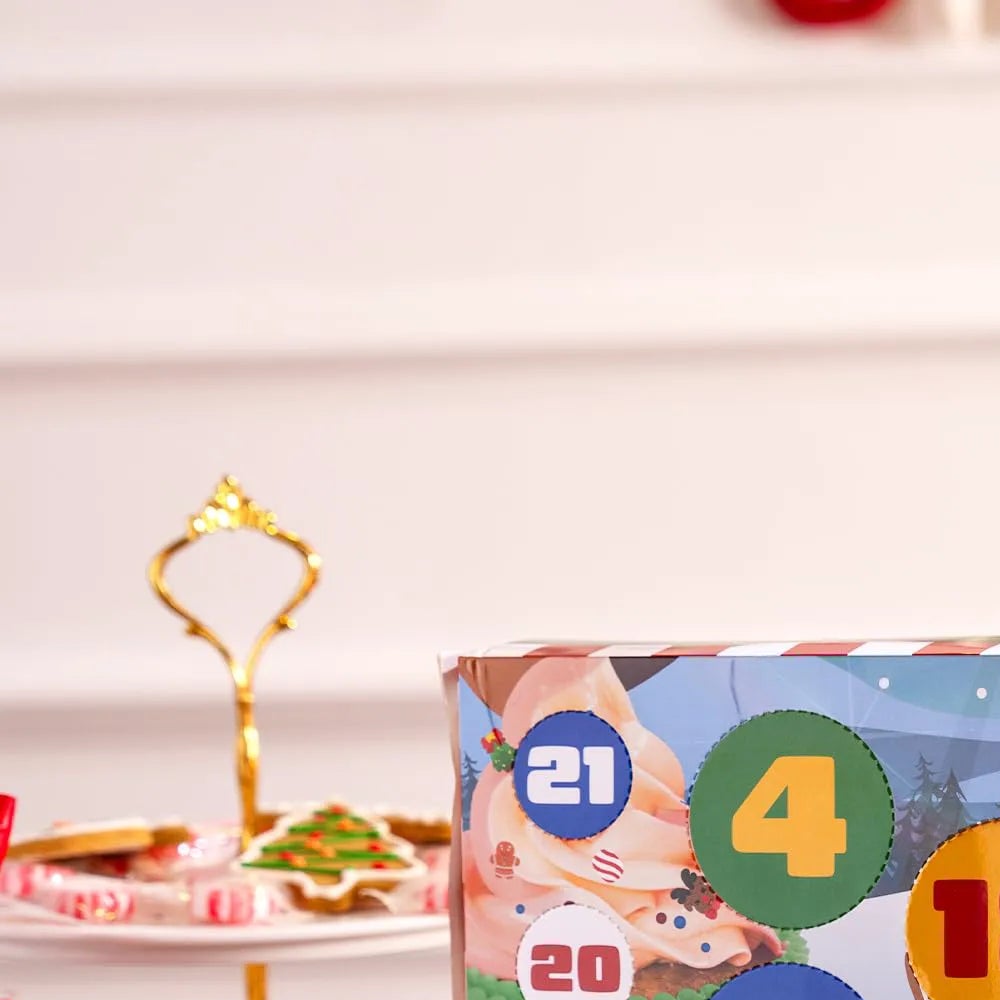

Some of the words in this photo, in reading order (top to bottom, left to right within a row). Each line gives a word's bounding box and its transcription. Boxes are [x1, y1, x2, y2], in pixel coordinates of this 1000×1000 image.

[527, 745, 615, 805] 21
[731, 756, 847, 877] 4
[530, 944, 622, 993] 20
